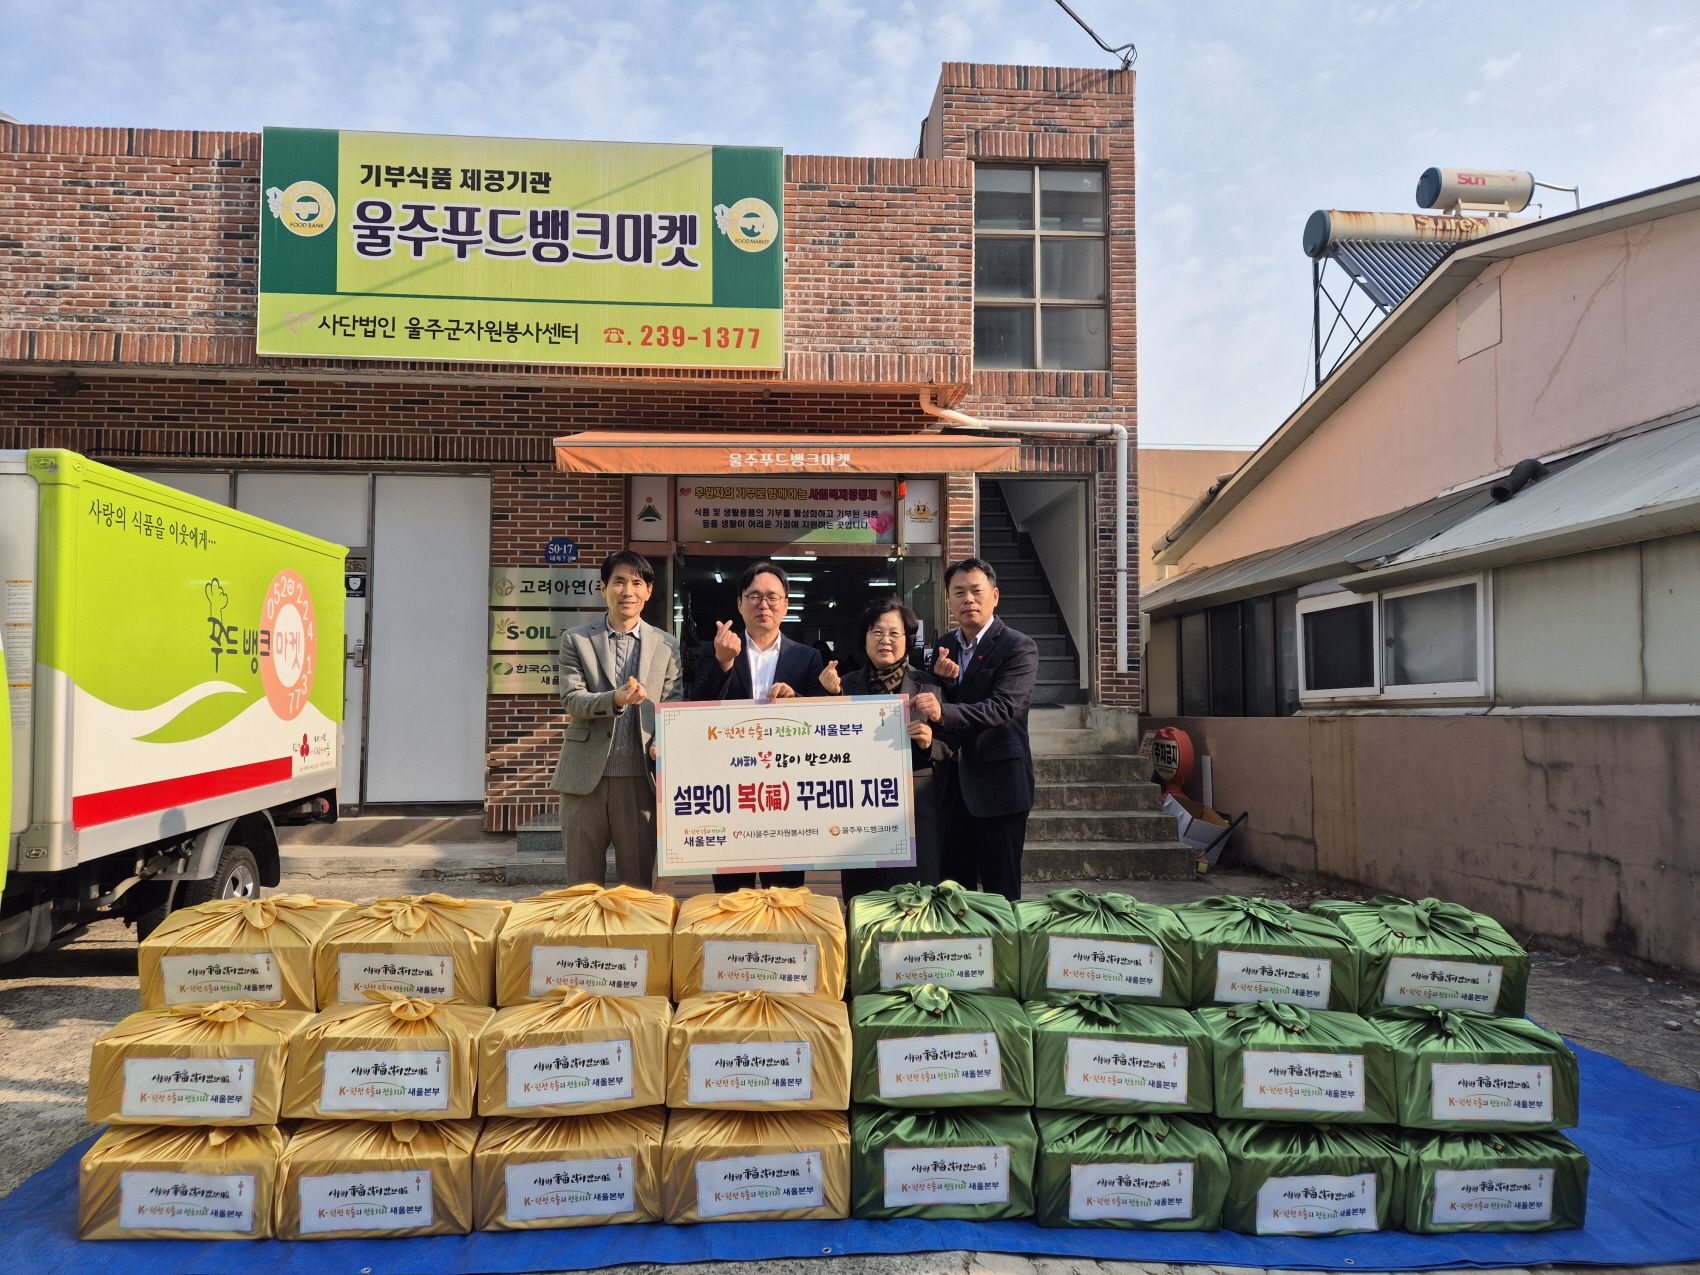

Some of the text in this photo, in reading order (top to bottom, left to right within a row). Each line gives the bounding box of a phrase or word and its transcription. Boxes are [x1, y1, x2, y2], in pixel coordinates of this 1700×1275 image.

[359, 163, 552, 194] 기부식품 제공기관
[352, 200, 700, 270] 울주푸드뱅크마켓
[318, 314, 580, 346] 사단법인 울주군자원봉사센터
[640, 325, 761, 351] 239-1377
[729, 453, 851, 468] 울주푸드뱅크마켓
[694, 486, 734, 500] 후원자의
[712, 508, 720, 517] 및
[88, 498, 126, 532] 사랑의
[132, 510, 165, 540] 식품을
[748, 520, 772, 528] 어려운
[548, 544, 573, 554] 50-17
[506, 626, 557, 640] S-OIL
[748, 723, 772, 740] 수출의
[775, 722, 812, 738] 전초기지
[814, 723, 863, 736] 새울본부
[730, 756, 757, 768] 새해
[775, 752, 801, 768] 많이
[805, 752, 852, 767] 받으세요
[673, 777, 900, 816] 설맞이 복(福) 꾸러미 지원
[743, 828, 819, 841] (사)울주군자원봉사센터
[684, 836, 726, 847] 새울본부
[779, 972, 807, 983] 새울본부
[956, 968, 985, 979] 새울본부
[608, 978, 638, 989] 새울본부
[1125, 973, 1154, 986] 새울본부
[243, 982, 273, 993] 새울본부
[1292, 986, 1320, 998] 새울본부
[1460, 991, 1489, 1003] 새울본부
[961, 1069, 992, 1080] 새울본부
[592, 1076, 623, 1088] 새울본부
[772, 1077, 803, 1087] 새울본부
[1148, 1077, 1178, 1089] 새울본부
[408, 1087, 440, 1097] 새울본부
[1325, 1087, 1356, 1098] 새울본부
[210, 1094, 243, 1104] 새울본부
[1513, 1098, 1543, 1109] 새울본부
[782, 1186, 814, 1198] 새울본부
[968, 1181, 1000, 1192] 새울본부
[593, 1191, 625, 1203] 새울본부
[1152, 1196, 1183, 1206] 새울본부
[390, 1205, 423, 1216] 새울본부
[1514, 1200, 1543, 1211] 새울본부
[210, 1208, 244, 1219] 새울본부
[1337, 1207, 1366, 1218] 새울본부
